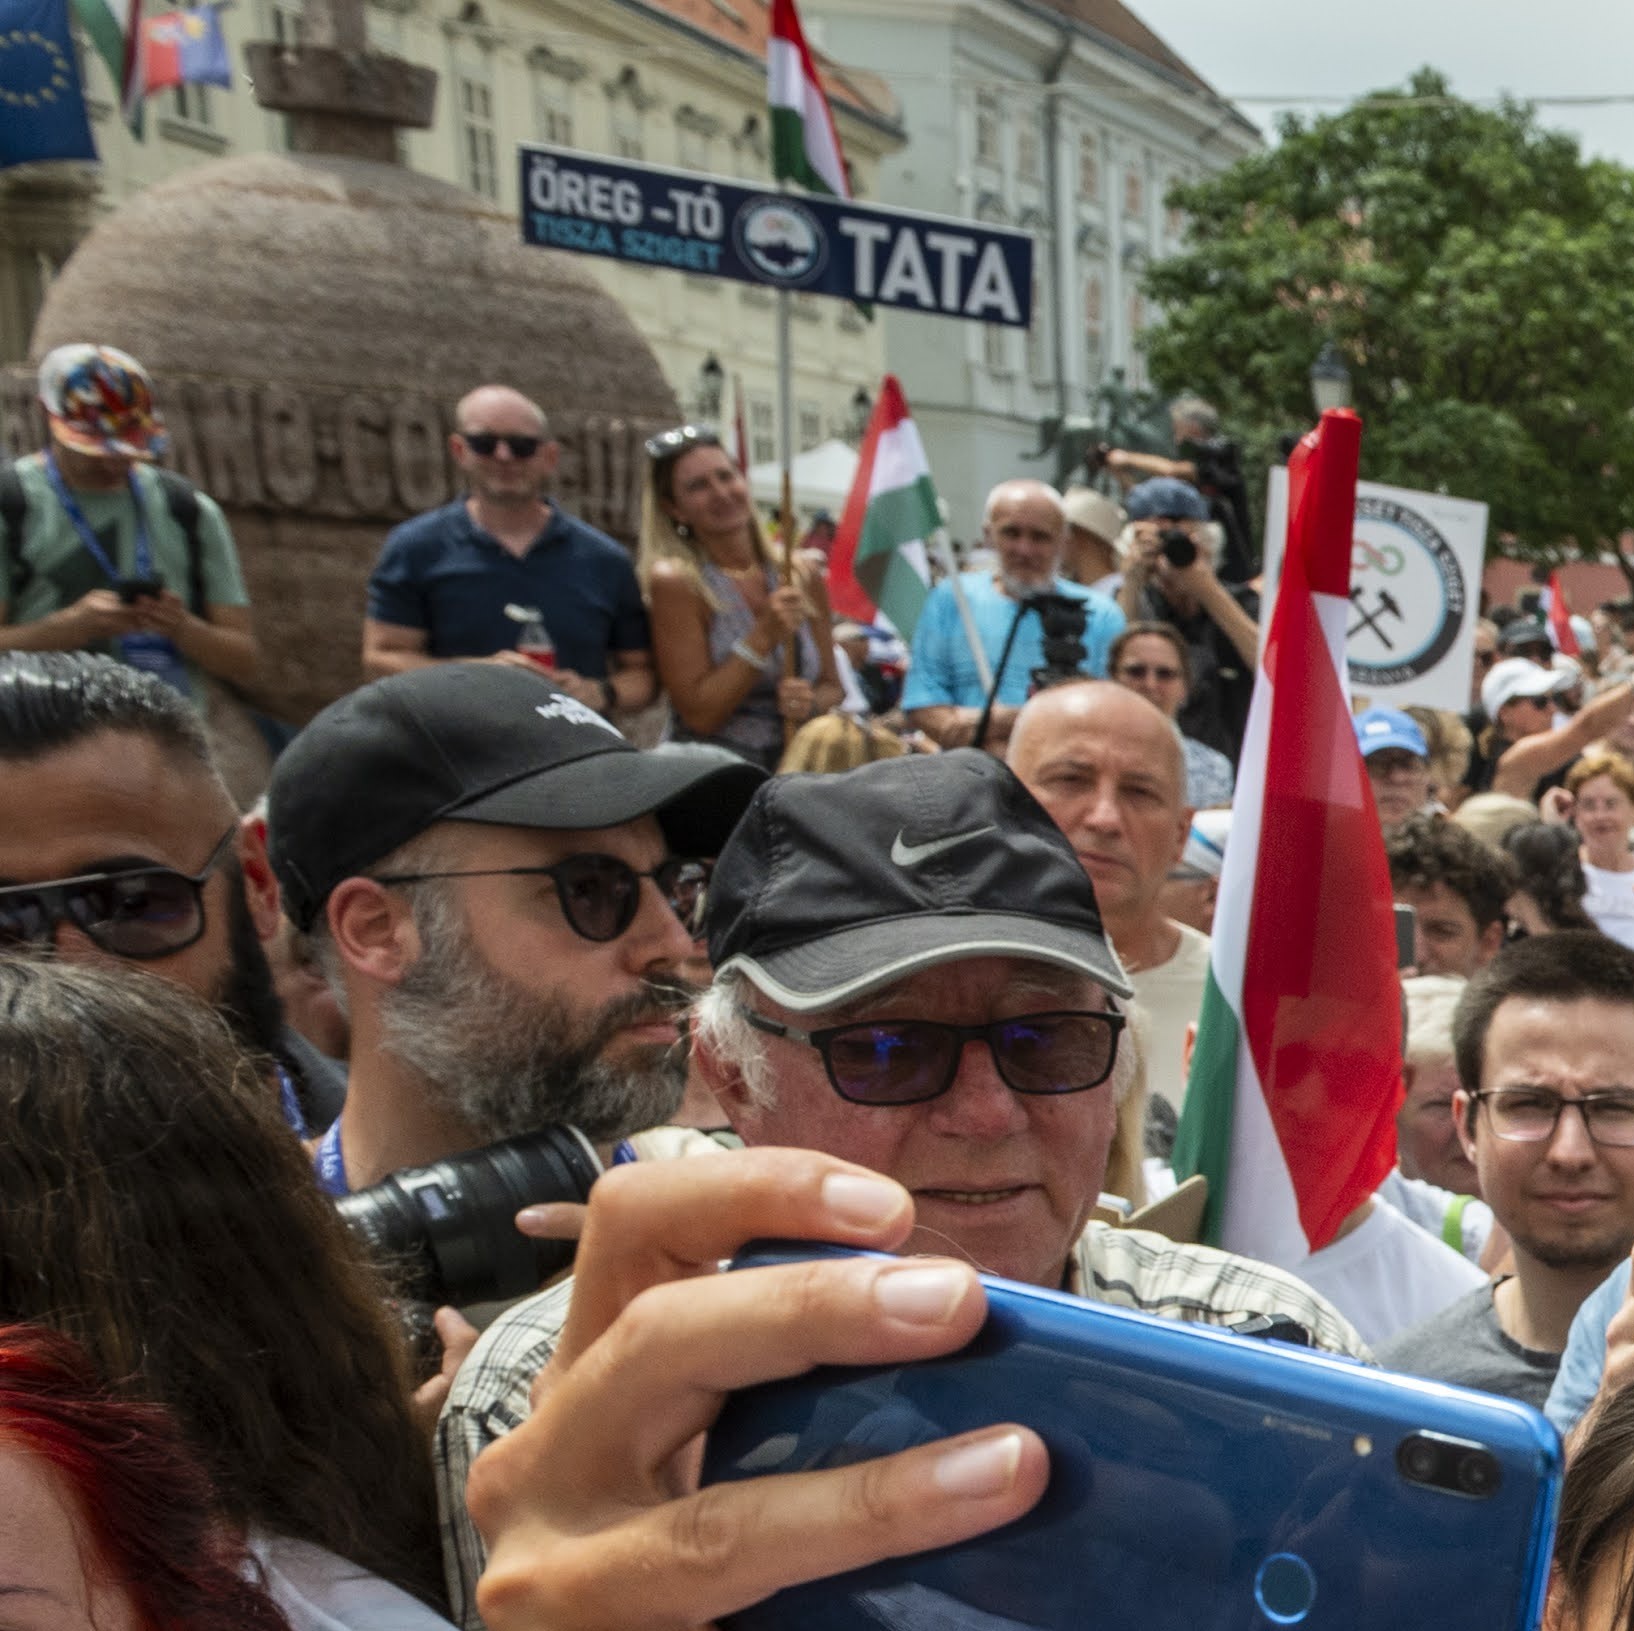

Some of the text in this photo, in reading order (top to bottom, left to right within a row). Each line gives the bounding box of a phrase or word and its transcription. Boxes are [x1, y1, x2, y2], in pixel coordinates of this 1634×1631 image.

[531, 212, 725, 272] TISZA SZIGET
[839, 216, 1022, 323] TATA
